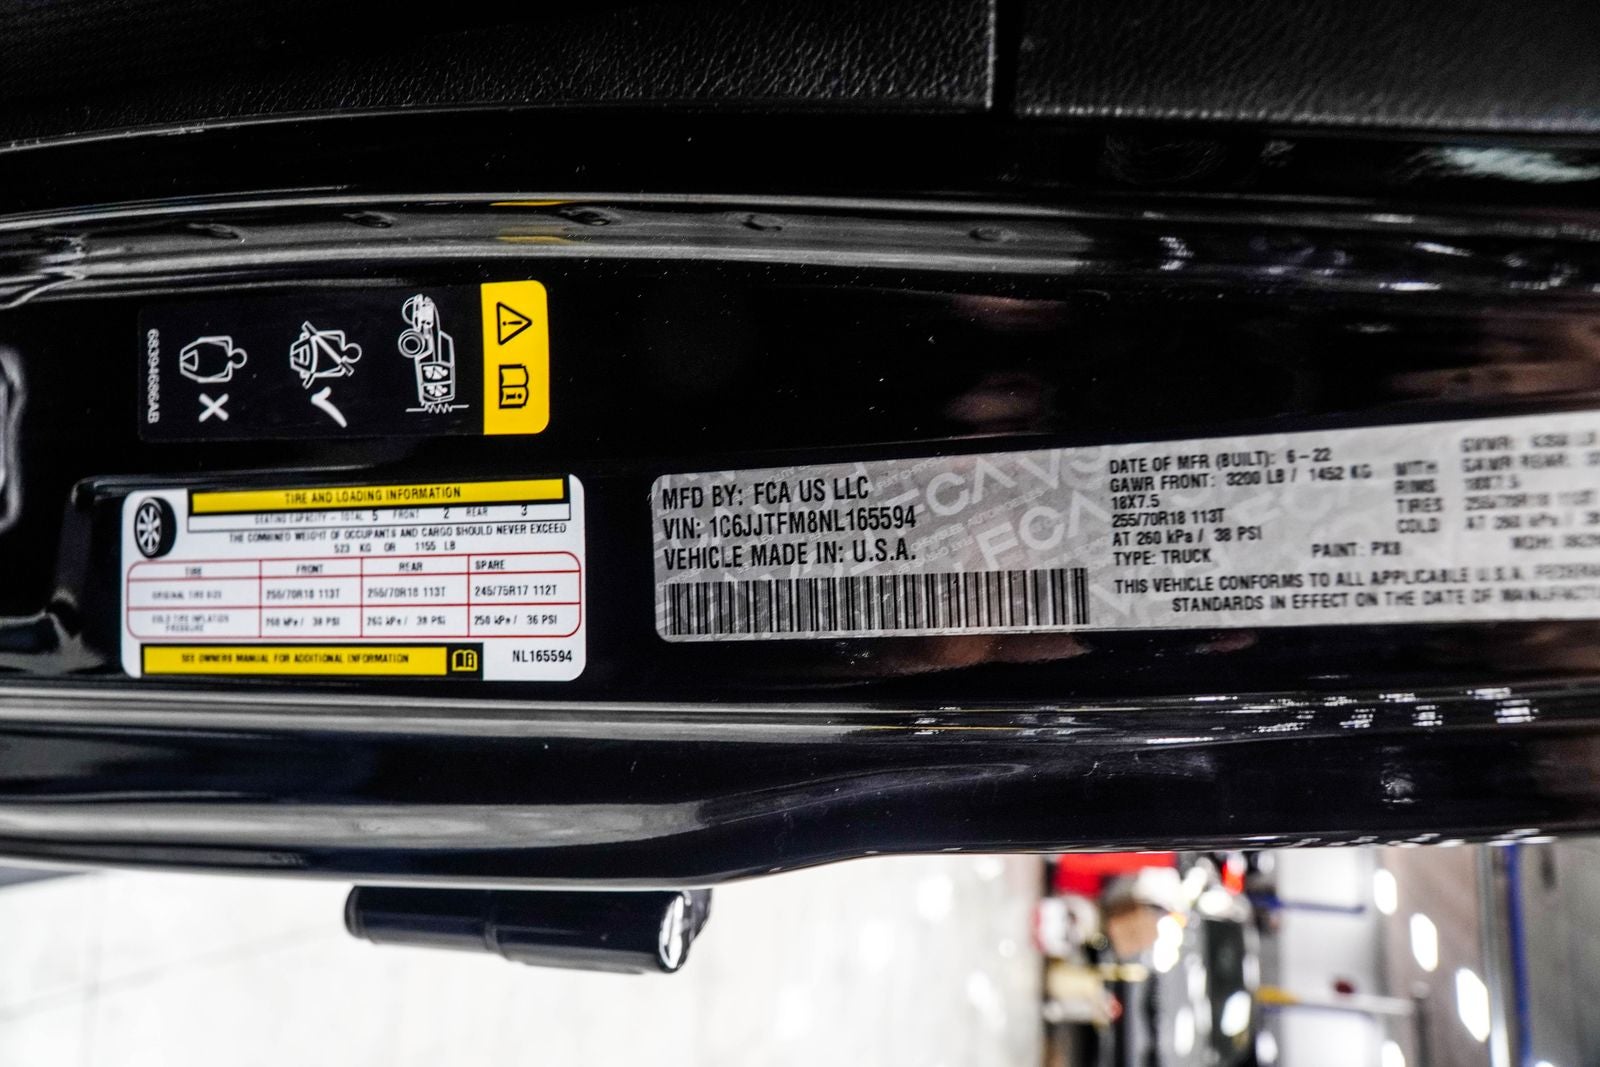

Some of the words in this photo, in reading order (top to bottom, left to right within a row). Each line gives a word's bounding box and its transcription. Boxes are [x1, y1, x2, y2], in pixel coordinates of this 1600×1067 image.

[1110, 457, 1148, 474] DATE
[1153, 456, 1171, 472] OF
[1177, 453, 1211, 471] MFR
[1215, 450, 1276, 468] (BUILT):
[1110, 476, 1156, 493] GAWR
[1160, 473, 1216, 490] FRONT:
[1267, 469, 1285, 484] LB
[1309, 466, 1345, 482] 1452
[285, 493, 308, 505] TIRE
[311, 492, 333, 504] AND
[336, 490, 382, 503] LOADING
[386, 486, 461, 500] INFORMATION
[662, 486, 704, 510] MFD
[712, 484, 744, 508] BY:
[754, 480, 791, 505] FCA
[799, 478, 826, 502] US
[833, 475, 869, 500] LLC
[1111, 494, 1160, 511] 18X7.5
[341, 511, 364, 522] TOTAL
[372, 510, 379, 521] 5
[392, 507, 420, 519] FRONT
[443, 507, 450, 519] 2
[465, 507, 488, 518] REAR
[520, 505, 528, 516] 3
[663, 516, 701, 540] VIN:
[709, 505, 917, 539] 1C6JJTFM8NL165594
[1112, 509, 1187, 528] 255/70R18
[1191, 508, 1225, 524] 113T
[229, 533, 244, 543] THE
[247, 531, 291, 543] COMBINED
[295, 530, 327, 542] WEIGHT
[330, 530, 340, 541] OF
[344, 529, 396, 541] OCCUPANTS
[400, 526, 418, 538] AND
[421, 526, 452, 537] CARGO
[456, 525, 493, 536] SHOULD
[496, 524, 526, 535] NEVER
[530, 522, 567, 534] EXCEED
[1112, 531, 1130, 547] AT
[1137, 530, 1162, 546] 260
[1166, 529, 1193, 544] kPa
[1214, 527, 1232, 542] 38
[1237, 526, 1262, 541] PSI
[334, 544, 350, 554] 523
[359, 543, 372, 553] KG
[384, 542, 396, 552] OR
[415, 542, 437, 552] 1155
[444, 541, 456, 551] LB
[664, 545, 743, 570] VEHICLE
[751, 542, 808, 567] MADE
[817, 540, 844, 564] IN:
[853, 537, 916, 563] U.S.A.
[475, 559, 506, 571] SPARE
[1113, 550, 1155, 566] TYPE:
[1161, 548, 1212, 565] TRUCK
[296, 564, 323, 574] FRONT
[399, 561, 423, 572] REAR
[474, 585, 529, 598] 245/75R17
[533, 584, 557, 596] 112T
[1114, 579, 1148, 594] THIS
[1153, 577, 1214, 593] VEHICLE
[1219, 573, 1303, 590] CONFORMS
[1309, 572, 1330, 587] TO
[1335, 571, 1365, 587] ALL
[1172, 596, 1264, 613] STANDARDS
[1270, 595, 1286, 610] IN
[1292, 593, 1349, 609] EFFECT
[1354, 591, 1378, 607] ON
[1384, 590, 1416, 606] THE
[474, 614, 491, 626] 250
[527, 614, 539, 625] 36
[541, 614, 558, 625] PSI
[182, 654, 195, 663] SEE
[199, 654, 232, 663] OWNERS
[236, 654, 269, 663] MANUAL
[274, 654, 290, 663] FOR
[294, 653, 343, 663] ADDITIONAL
[347, 653, 409, 663] INFORMATION
[512, 649, 573, 663] NL165594
